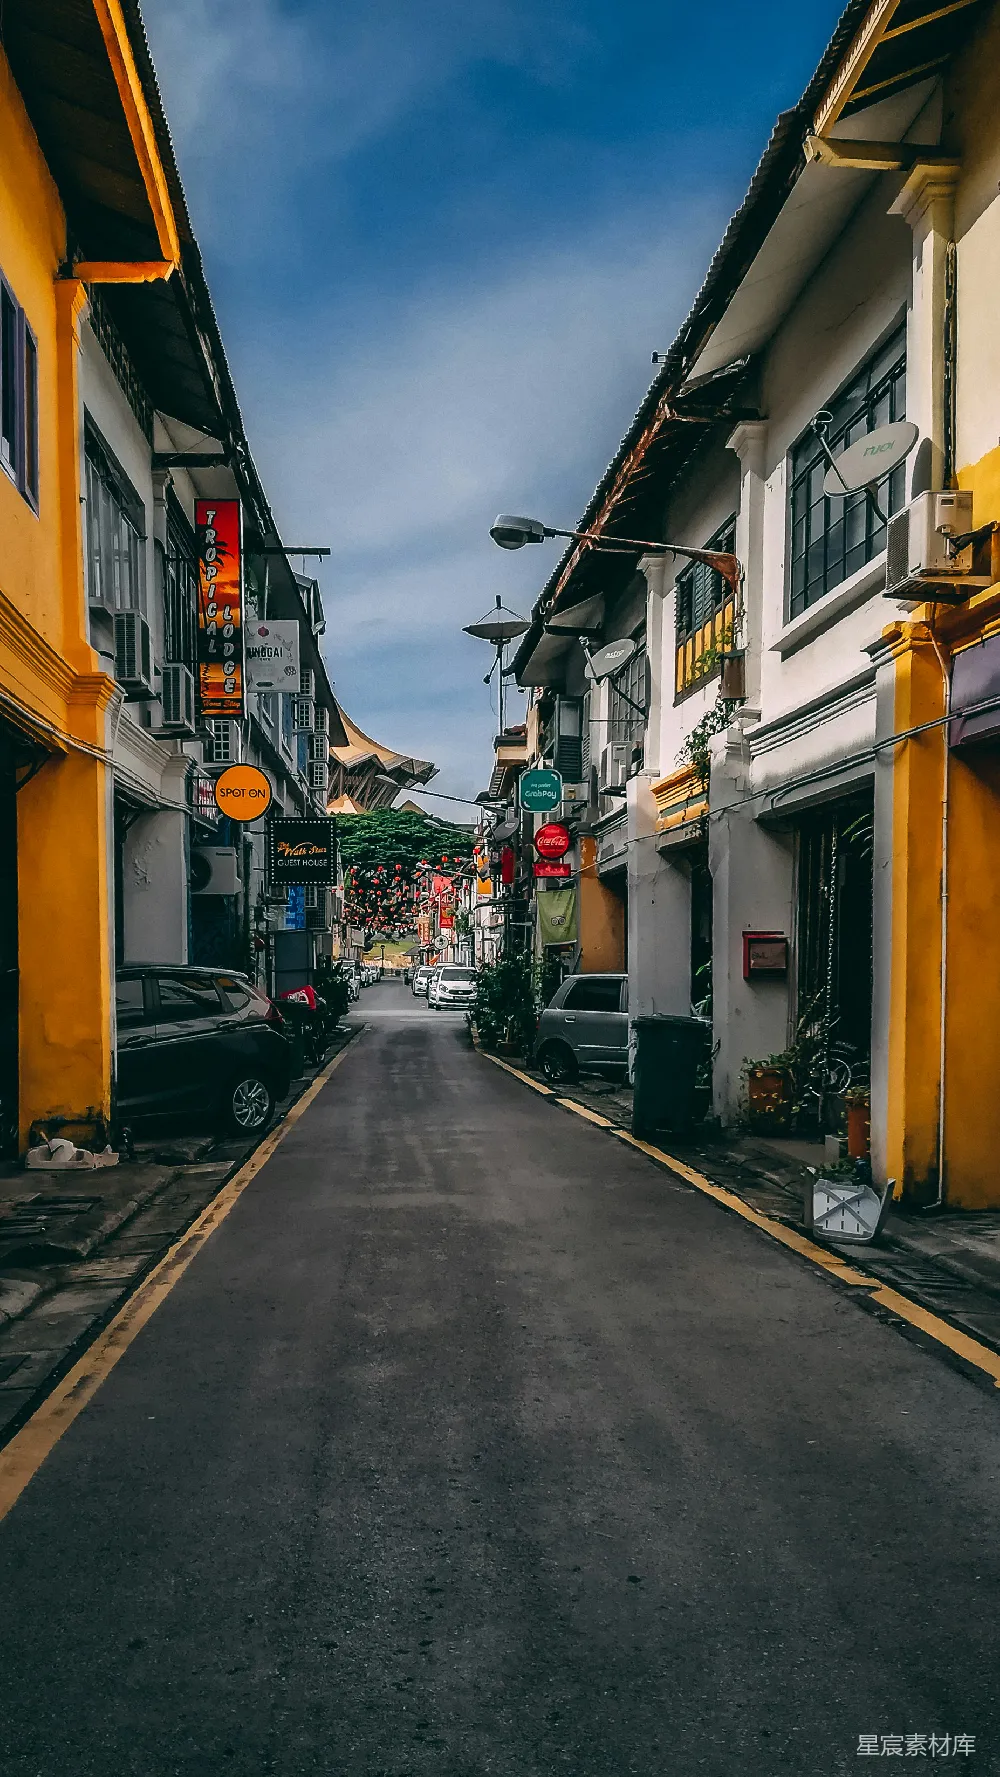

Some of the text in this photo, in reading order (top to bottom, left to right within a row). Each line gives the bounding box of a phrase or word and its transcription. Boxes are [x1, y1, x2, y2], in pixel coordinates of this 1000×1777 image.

[205, 509, 217, 654] TROPICAL
[222, 605, 236, 694] LODGE
[219, 788, 266, 798] SPOT ON
[524, 789, 557, 800] GrabPay
[537, 835, 568, 846] Coca-Cola
[277, 859, 328, 867] GUEST HOUSE
